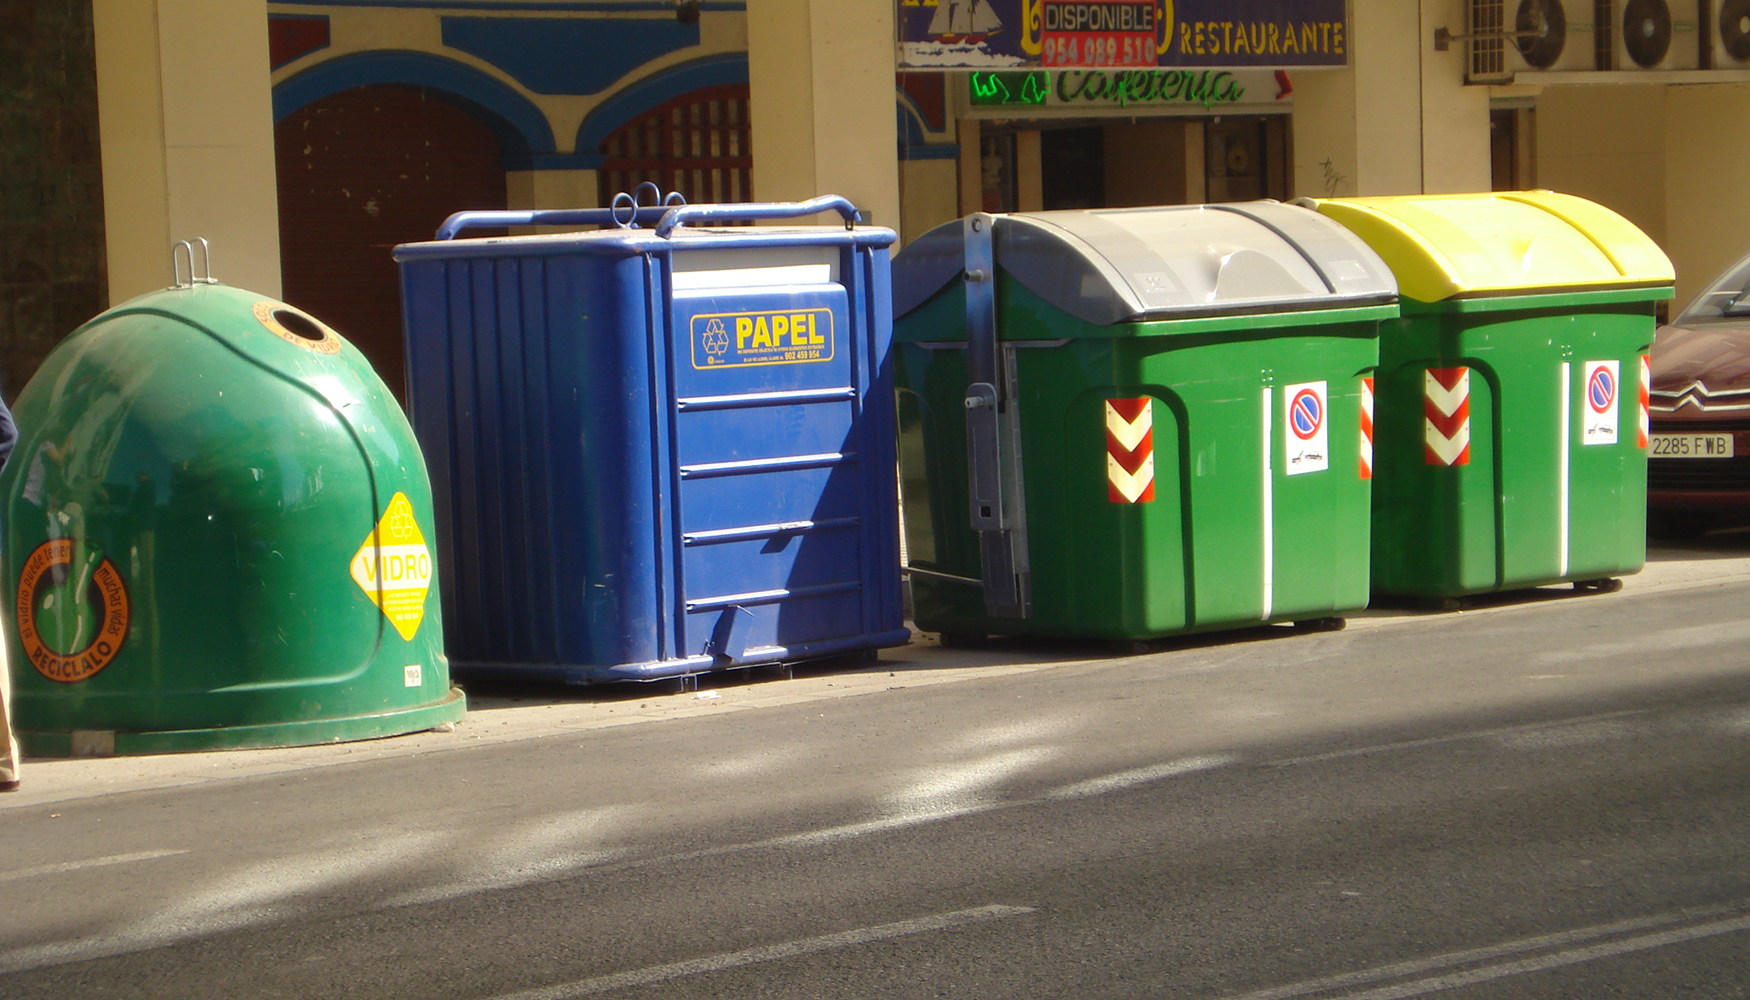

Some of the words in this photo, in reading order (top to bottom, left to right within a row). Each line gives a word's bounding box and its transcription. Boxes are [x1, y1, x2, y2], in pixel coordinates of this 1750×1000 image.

[1045, 4, 1153, 30] DISPONIBLE
[1045, 37, 1078, 63] 954
[1085, 37, 1117, 65] 089
[1123, 37, 1155, 63] 510
[1181, 21, 1344, 54] RESTAURANTE
[736, 314, 825, 349] PAPEL
[785, 351, 796, 360] 902
[797, 350, 808, 359] 459
[1653, 437, 1690, 454] 2285
[1694, 437, 1726, 454] FWB
[43, 545, 70, 561] tener
[362, 553, 429, 582] VIDRO
[23, 554, 45, 589] puede
[97, 567, 122, 607] muchas
[20, 589, 31, 625] vidrio
[21, 627, 33, 639] el
[107, 608, 126, 638] vidas
[32, 641, 112, 678] RECICLALO
